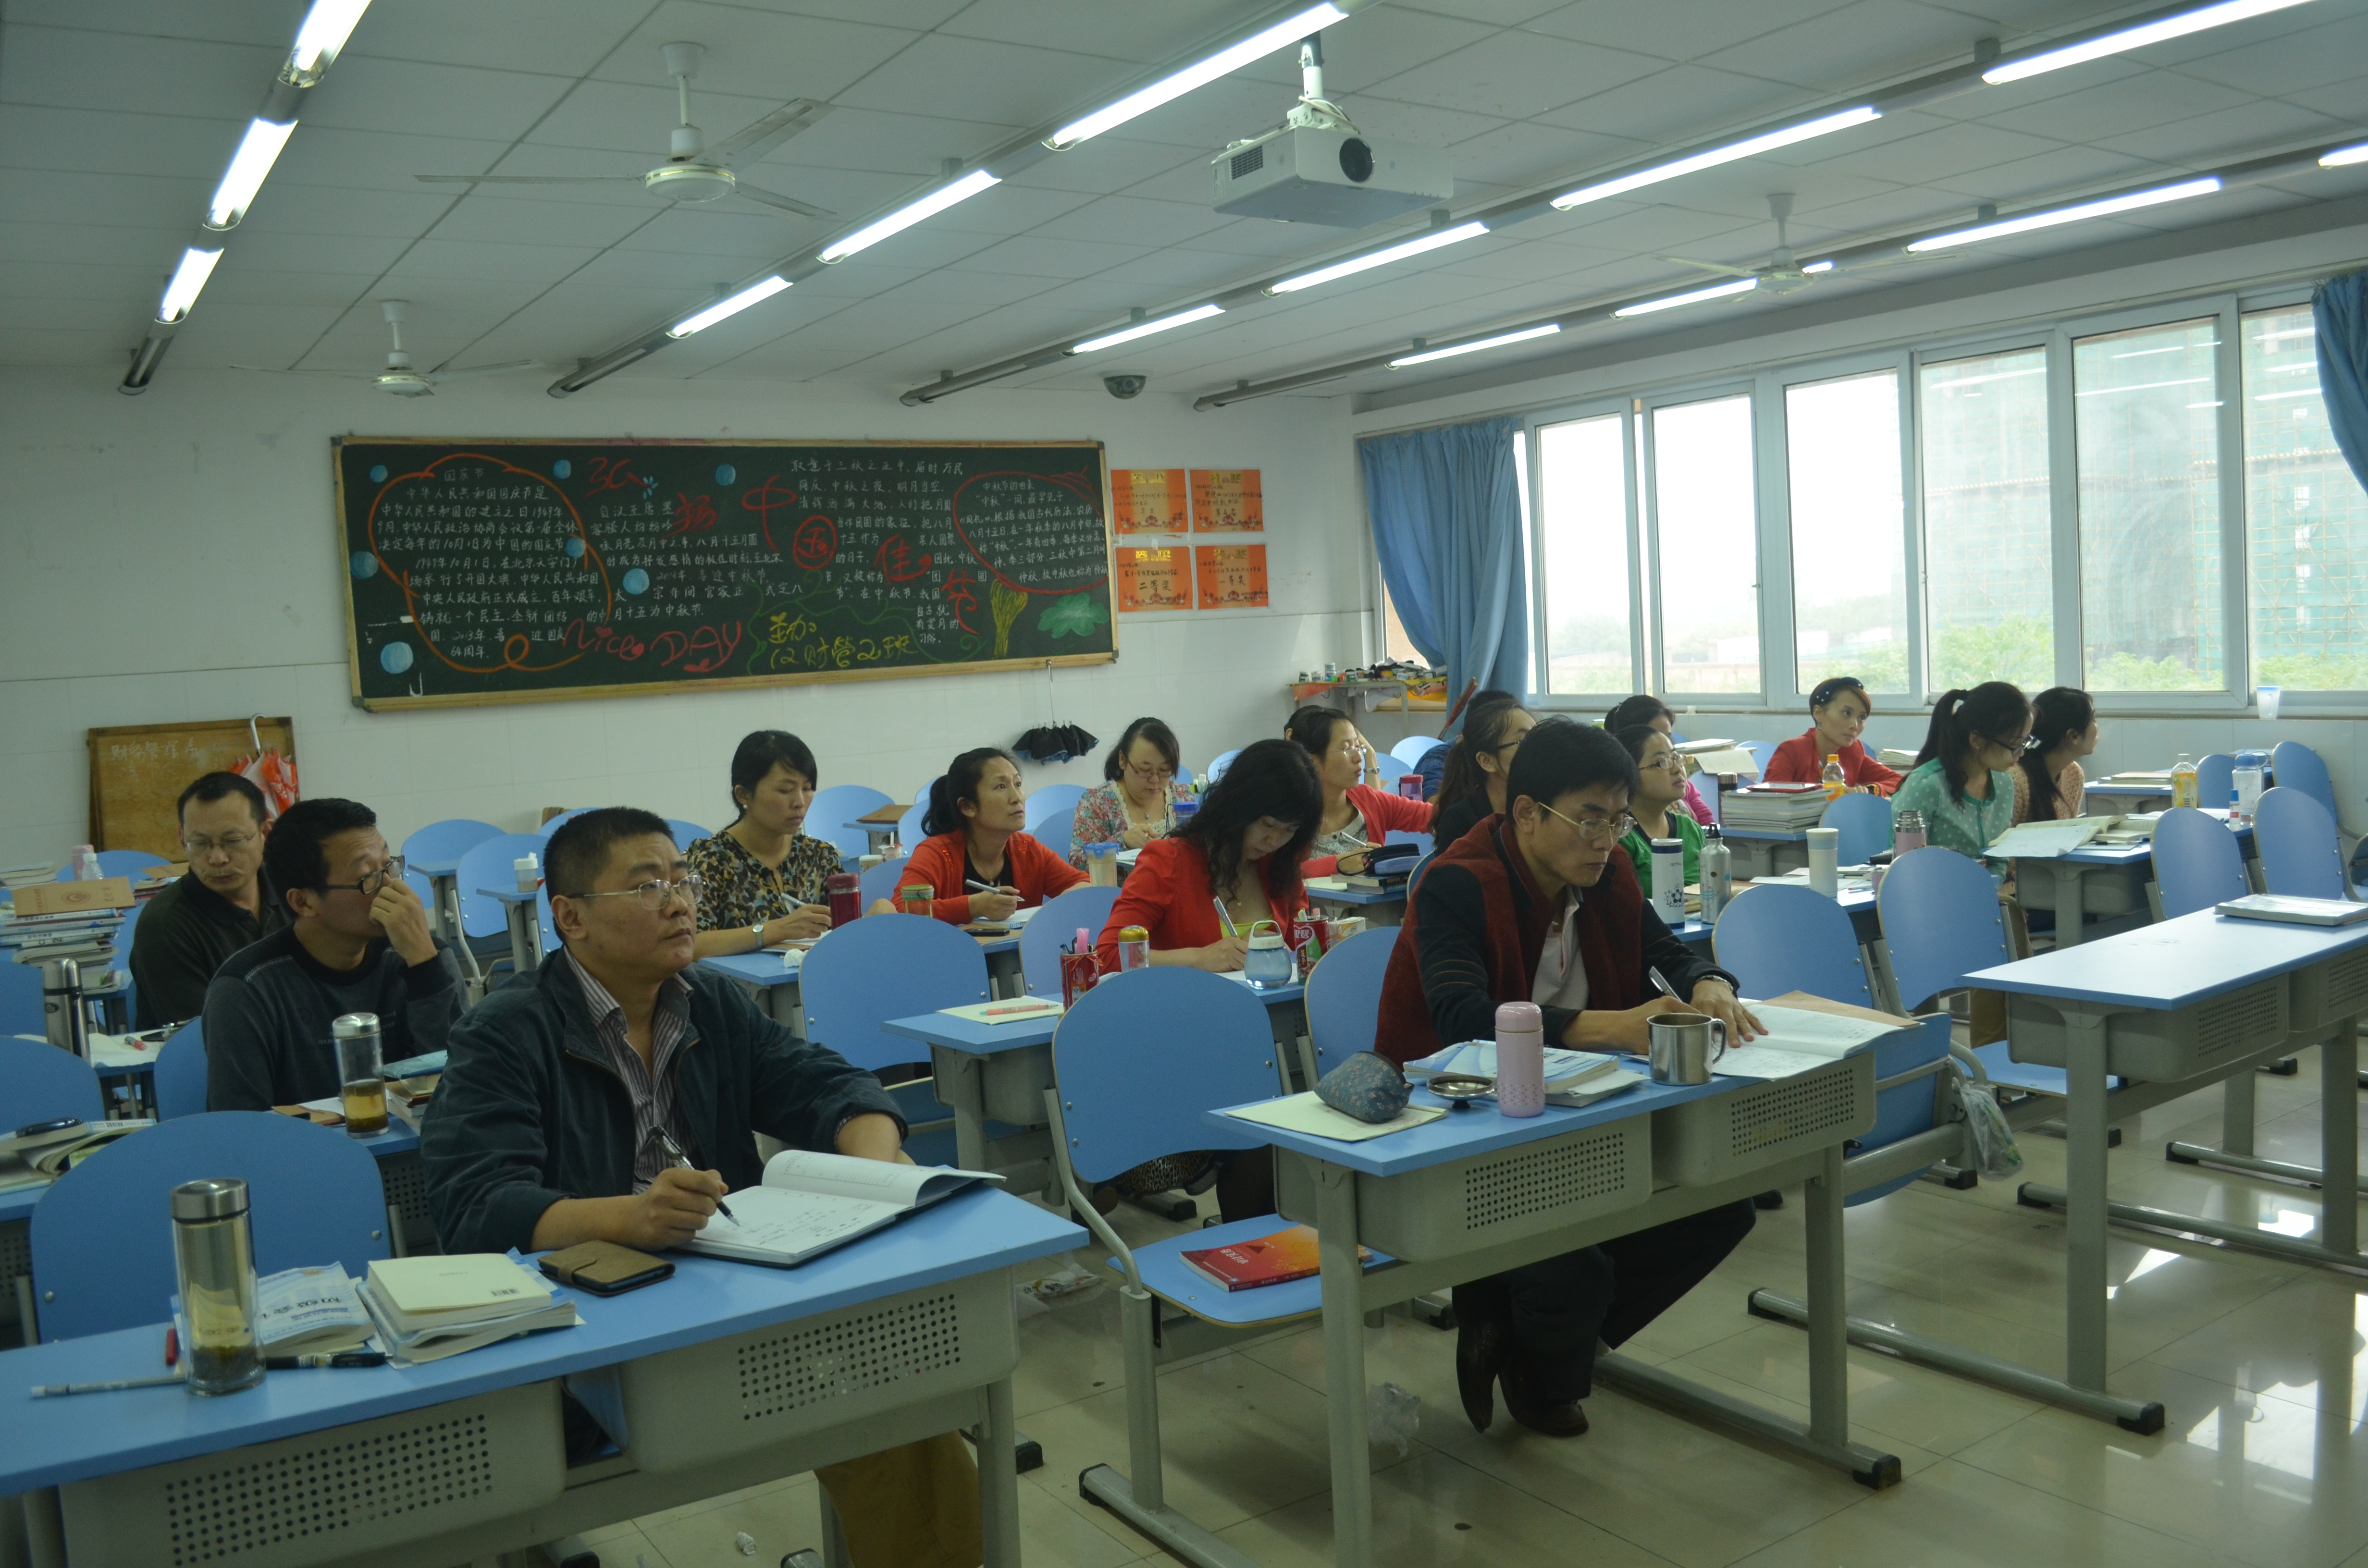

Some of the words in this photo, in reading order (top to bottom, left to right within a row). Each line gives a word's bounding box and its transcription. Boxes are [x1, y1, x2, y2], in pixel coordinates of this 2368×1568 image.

[444, 467, 484, 482] 国庆节
[983, 479, 1035, 491] 中秋节的由来
[406, 485, 549, 501] 中华人民共和国国庆节是
[839, 532, 879, 545] 十五作为
[1139, 579, 1172, 592] 二等奖
[917, 605, 950, 616] 自古就
